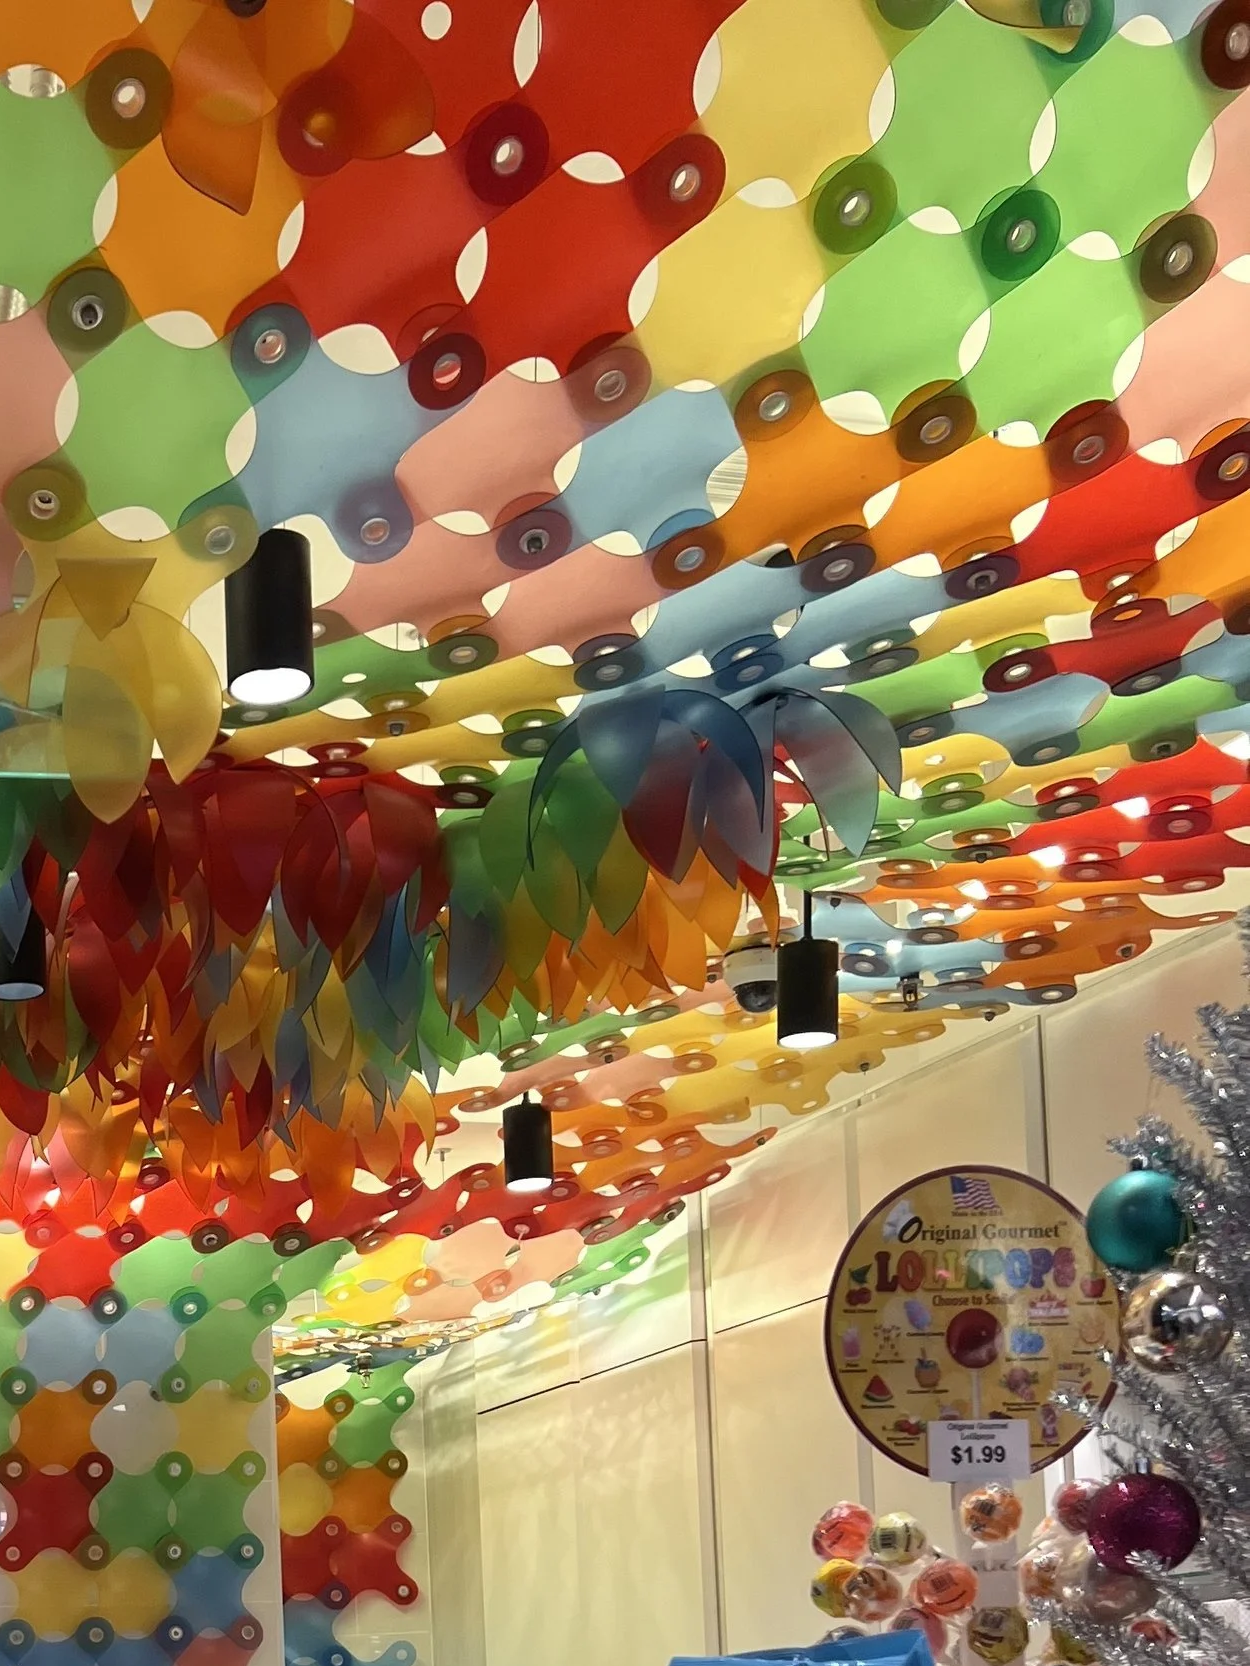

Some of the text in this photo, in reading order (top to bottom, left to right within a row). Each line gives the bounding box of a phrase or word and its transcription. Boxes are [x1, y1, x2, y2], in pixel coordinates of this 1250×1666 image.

[898, 1215, 1060, 1244] Original Gourmet
[874, 1246, 1077, 1293] LOLLIPOPS
[932, 1295, 970, 1307] Choose
[972, 1295, 983, 1306] to
[951, 1445, 1006, 1466] $1.99
